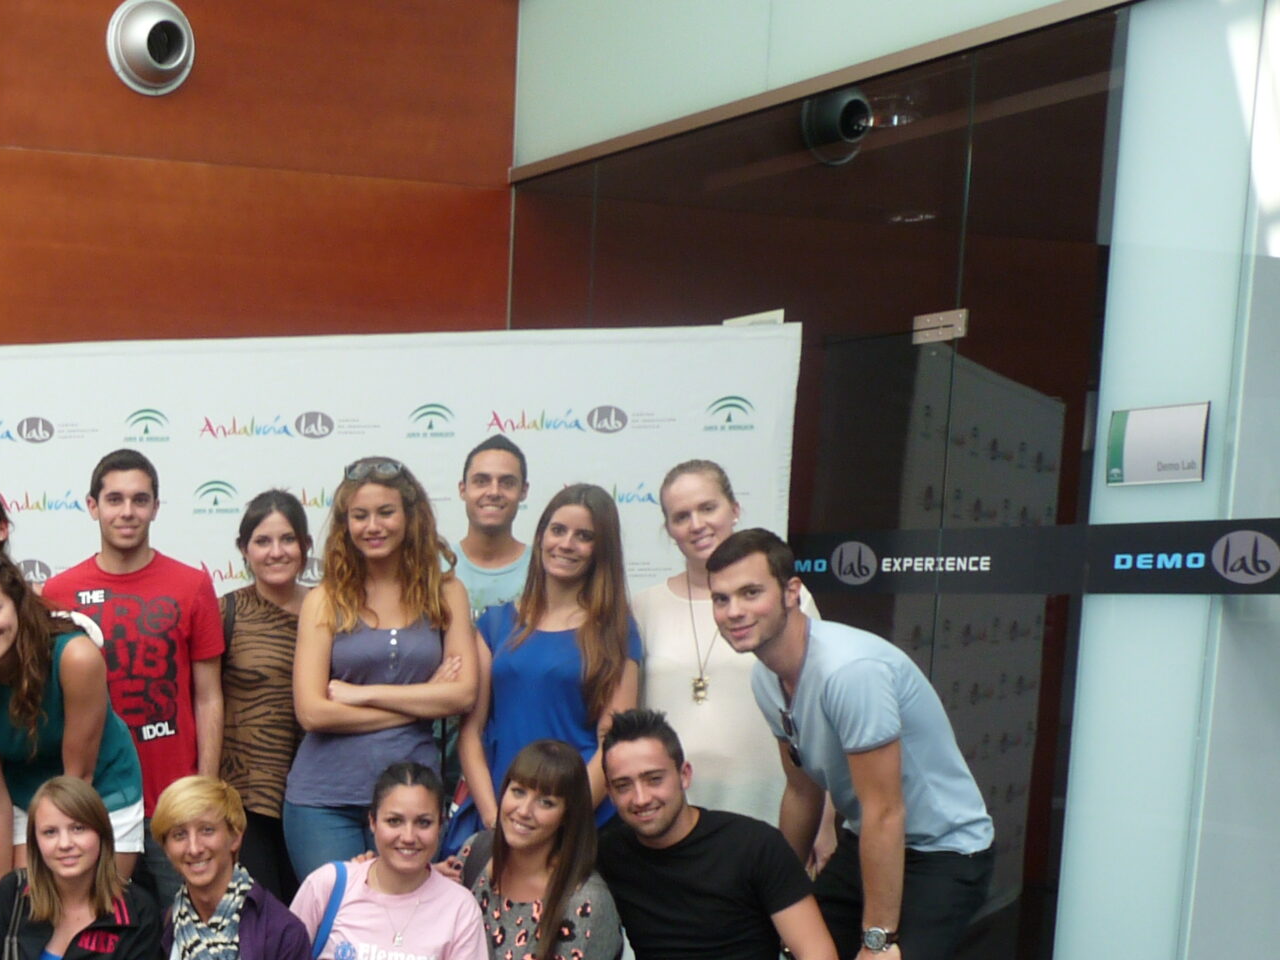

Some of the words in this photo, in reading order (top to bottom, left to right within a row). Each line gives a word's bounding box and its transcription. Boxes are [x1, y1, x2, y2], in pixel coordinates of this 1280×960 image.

[23, 418, 50, 440] lab
[300, 414, 329, 434] lab
[592, 407, 622, 430] lab
[1157, 461, 1180, 472] Demo
[1182, 460, 1197, 471] Lab
[794, 559, 827, 572] MO
[838, 546, 870, 578] lab
[881, 556, 991, 572] EXPERIENCE
[1114, 552, 1206, 570] DEMO
[1223, 536, 1272, 576] lab
[78, 590, 105, 604] THE
[77, 932, 120, 953] NIKE
